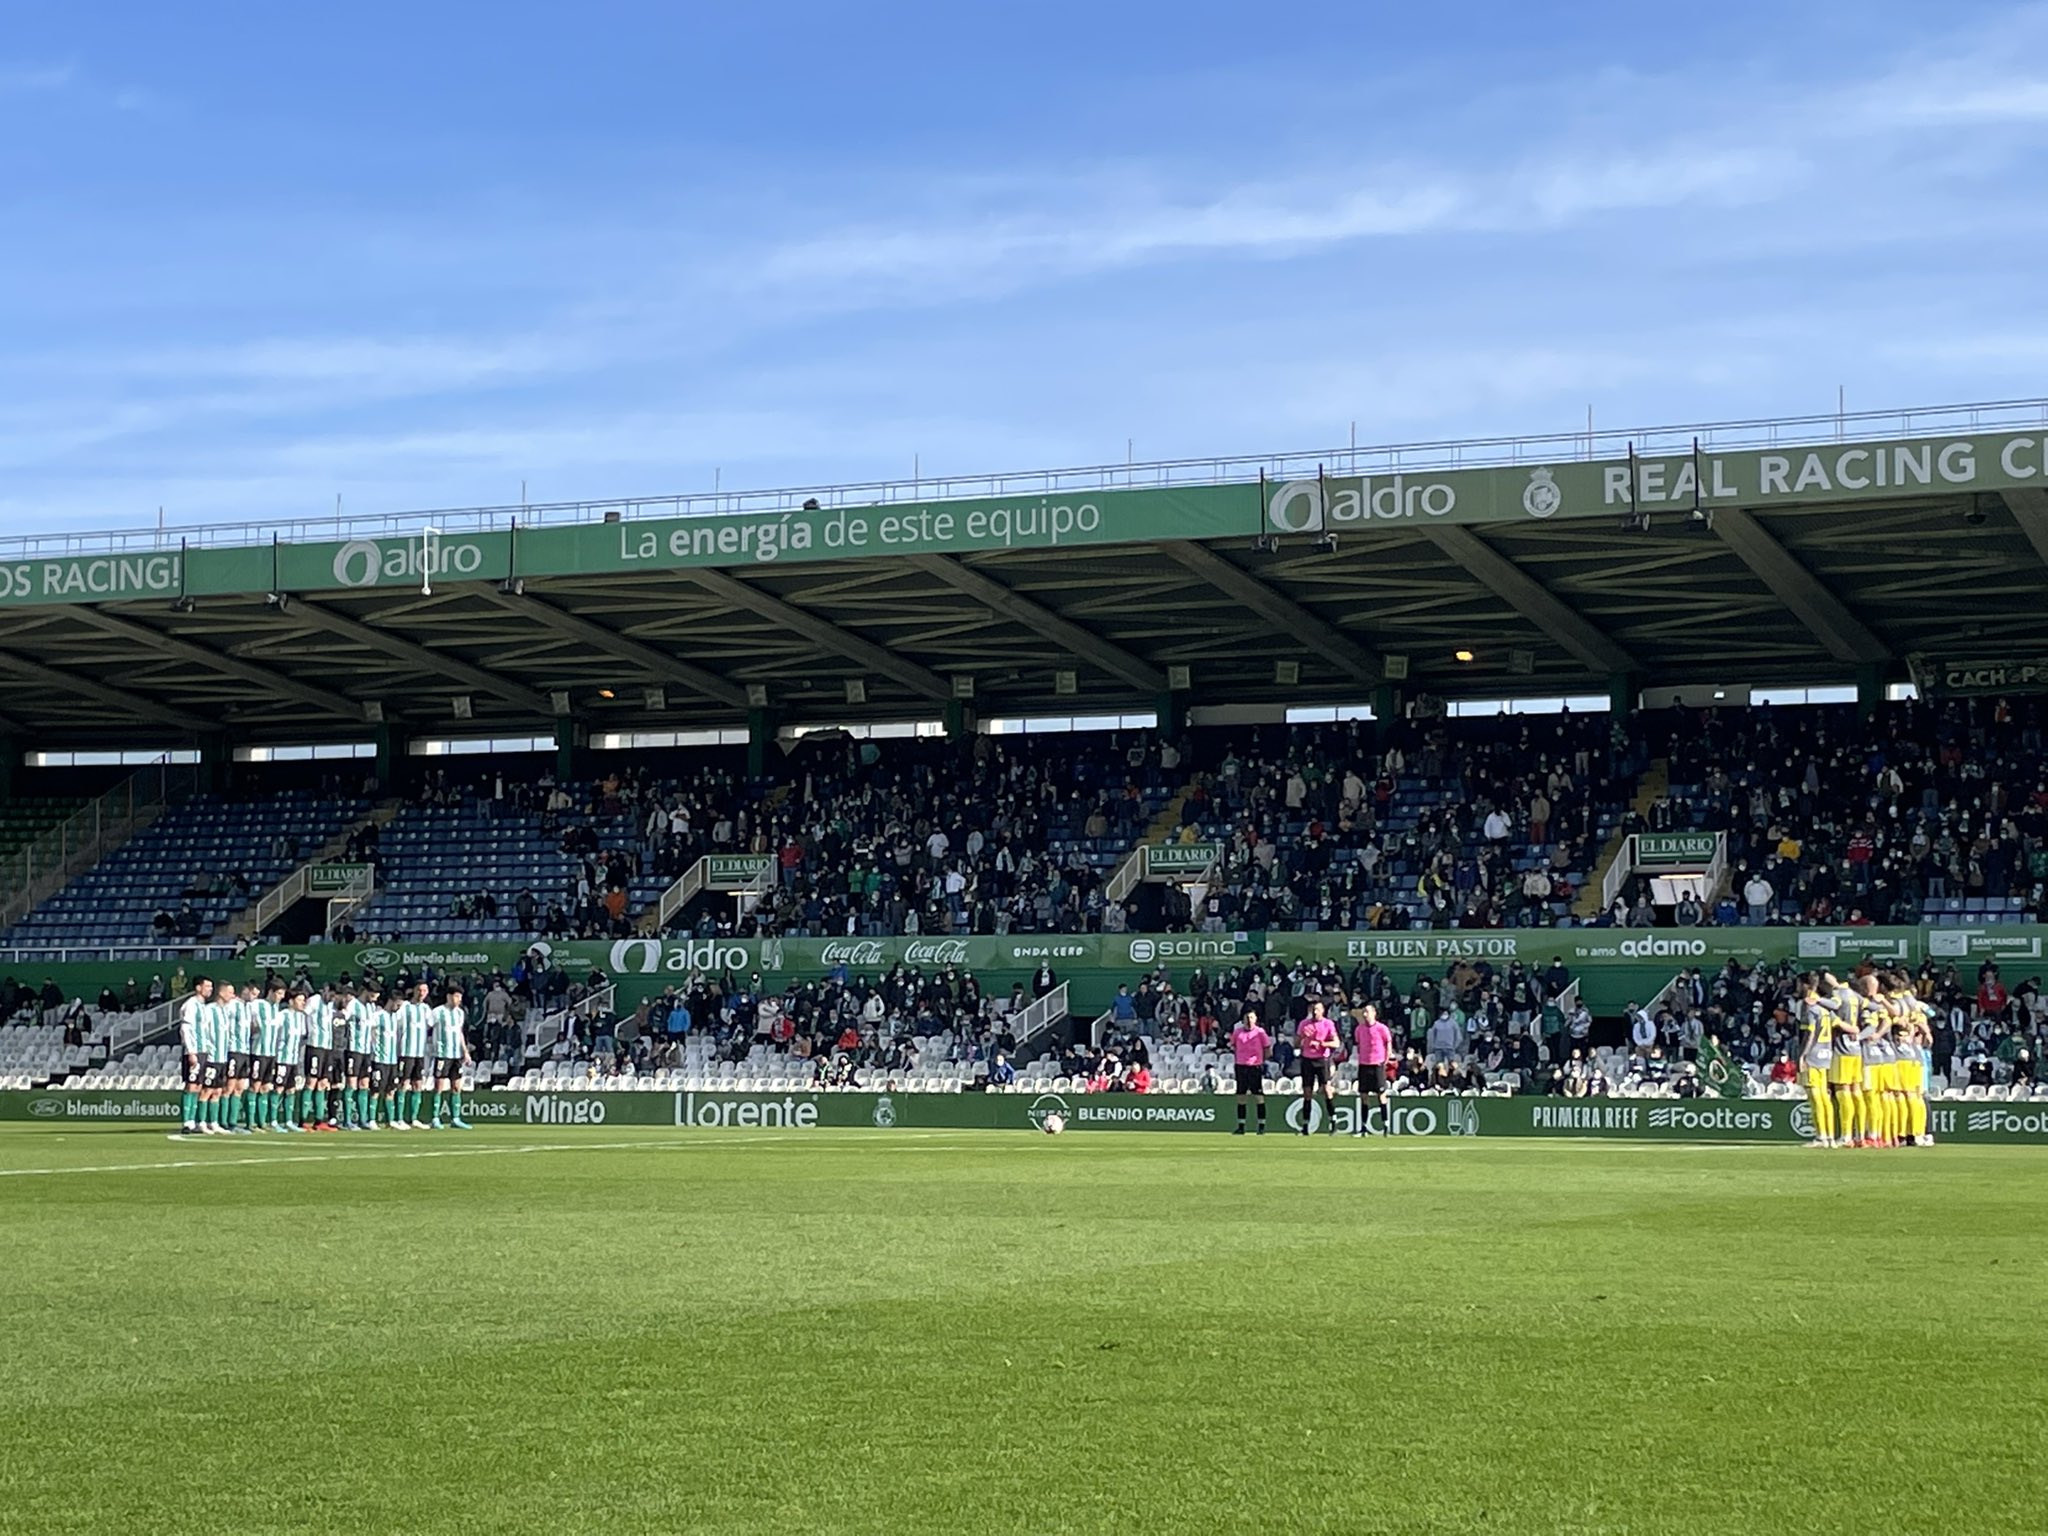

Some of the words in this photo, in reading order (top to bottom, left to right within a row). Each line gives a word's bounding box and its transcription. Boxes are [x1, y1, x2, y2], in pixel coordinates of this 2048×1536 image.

[1604, 459, 1738, 505] REAL
[1760, 442, 1976, 494] RACING
[2001, 437, 2048, 479] C
[1332, 475, 1456, 521] aldro
[620, 526, 658, 560] La
[668, 513, 812, 562] energía
[824, 512, 868, 547] de
[879, 508, 954, 544] este
[966, 499, 1100, 546] equipo
[383, 535, 482, 577] aldro
[43, 558, 179, 596] RACING!
[1151, 849, 1167, 862] EL
[1168, 848, 1214, 861] DIARIO
[1640, 838, 1659, 852] EL
[1661, 837, 1713, 852] DIARIO
[712, 859, 726, 872] EL
[728, 858, 770, 871] DIARIO
[403, 952, 445, 964] blendio
[446, 952, 489, 964] alisauto
[666, 939, 748, 971] aldro
[1013, 947, 1049, 957] ONDA
[1052, 946, 1084, 957] CERO
[1347, 940, 1371, 957] EL
[1375, 939, 1428, 957] BUEN
[1436, 938, 1517, 956] PASTOR
[1590, 947, 1617, 957] amo
[1620, 934, 1707, 958] adamo
[66, 1100, 122, 1117] blendio
[123, 1100, 181, 1117] alisauto
[439, 1099, 507, 1117] Achoas
[526, 1094, 606, 1124] Mingo
[675, 1092, 818, 1128] llorente
[1078, 1106, 1142, 1121] BLENDIO
[1146, 1107, 1216, 1122] PARAYAS
[1533, 1106, 1600, 1129] PRIMERA
[1605, 1107, 1639, 1129] RFEF
[1670, 1106, 1773, 1130] Footters
[1931, 1110, 1957, 1132] FEF
